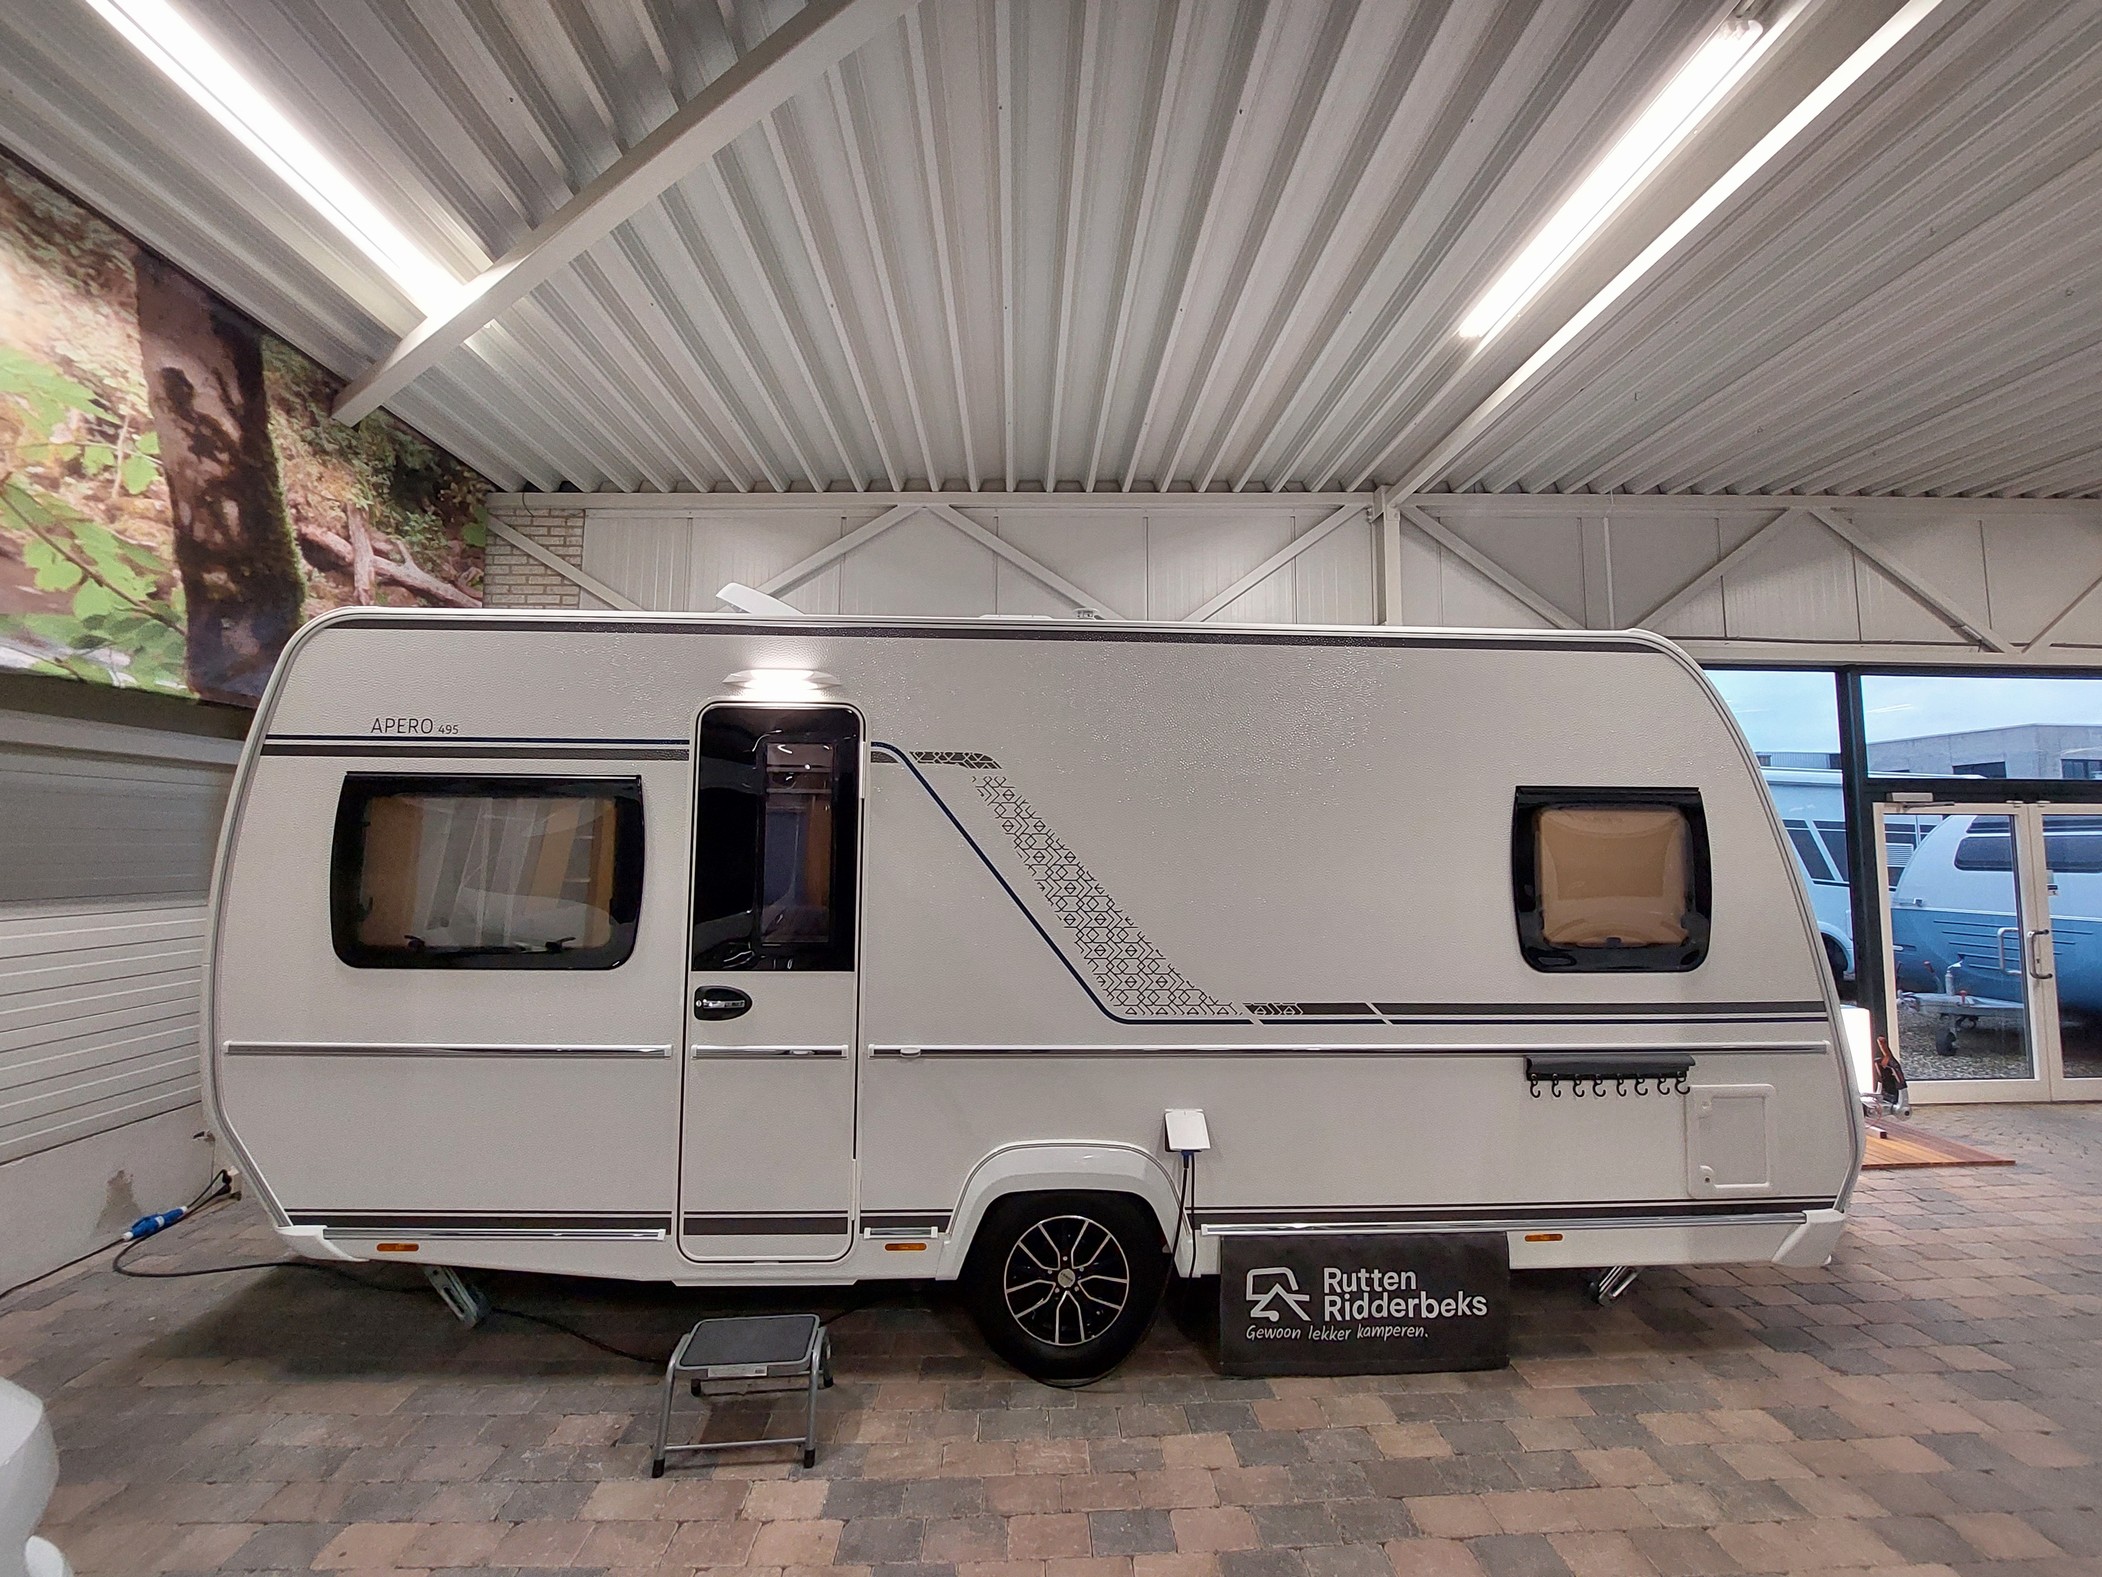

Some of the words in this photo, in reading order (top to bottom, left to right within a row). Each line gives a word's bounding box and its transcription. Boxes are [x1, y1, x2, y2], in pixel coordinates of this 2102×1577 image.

[370, 717, 434, 735] APERO
[437, 724, 459, 735] 495
[1323, 1267, 1418, 1294] Rutten
[1324, 1290, 1488, 1322] Ridderbeks
[1246, 1324, 1302, 1340] Gewoon
[1308, 1324, 1352, 1341] lekker
[1356, 1323, 1429, 1342] kamperen.
